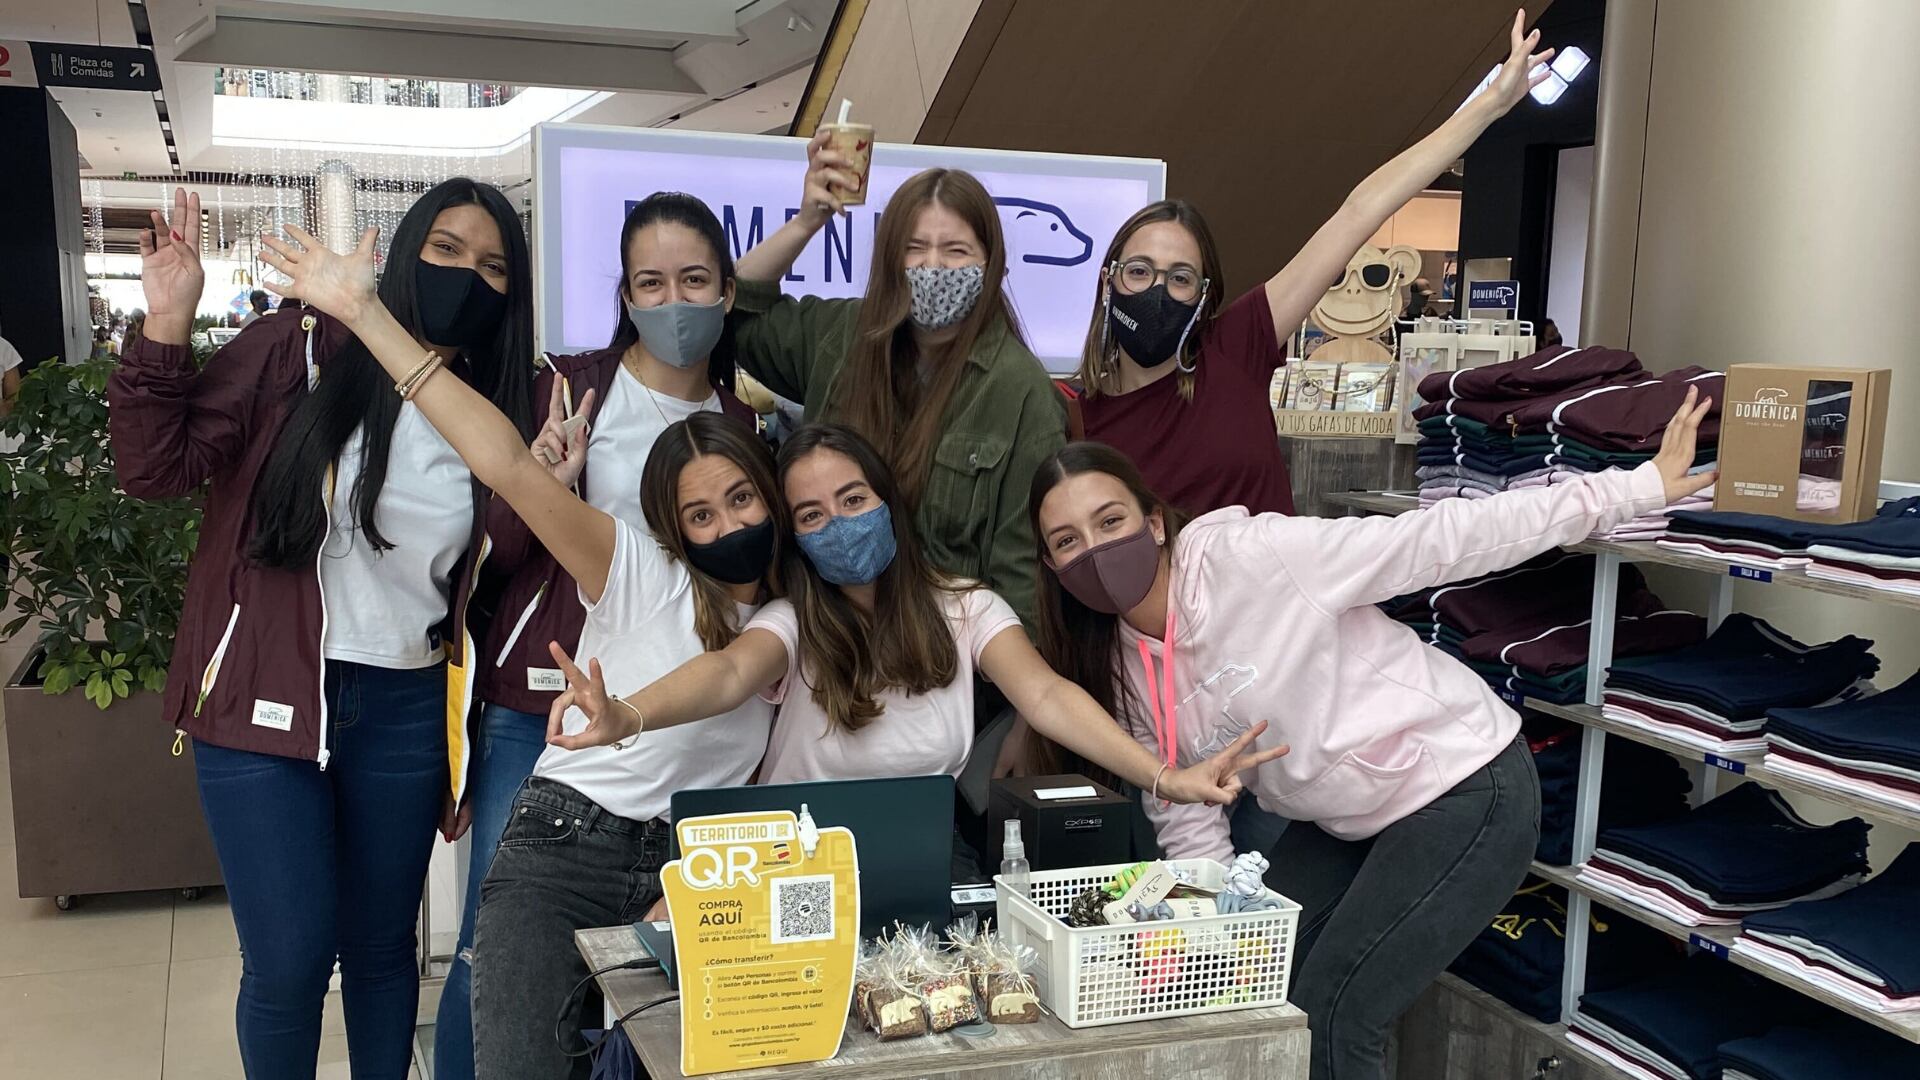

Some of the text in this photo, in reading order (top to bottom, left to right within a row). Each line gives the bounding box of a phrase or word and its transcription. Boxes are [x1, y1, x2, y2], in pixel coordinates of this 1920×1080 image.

[70, 56, 113, 68] Plaza de
[70, 65, 114, 78] Comidas
[1472, 289, 1503, 299] DOMENICA
[1735, 403, 1798, 421] DOMENICA
[1291, 416, 1305, 432] TUS
[1309, 416, 1341, 433] GAFAS
[1345, 417, 1357, 433] DE
[1360, 417, 1393, 436] MODA
[691, 825, 768, 842] TERRITORIO
[682, 847, 759, 888] QR
[698, 900, 743, 911] COMPRA
[699, 907, 743, 927] AQUÍ
[723, 932, 767, 942] Bancolombia
[705, 953, 774, 967] ¿Cómo transferir?
